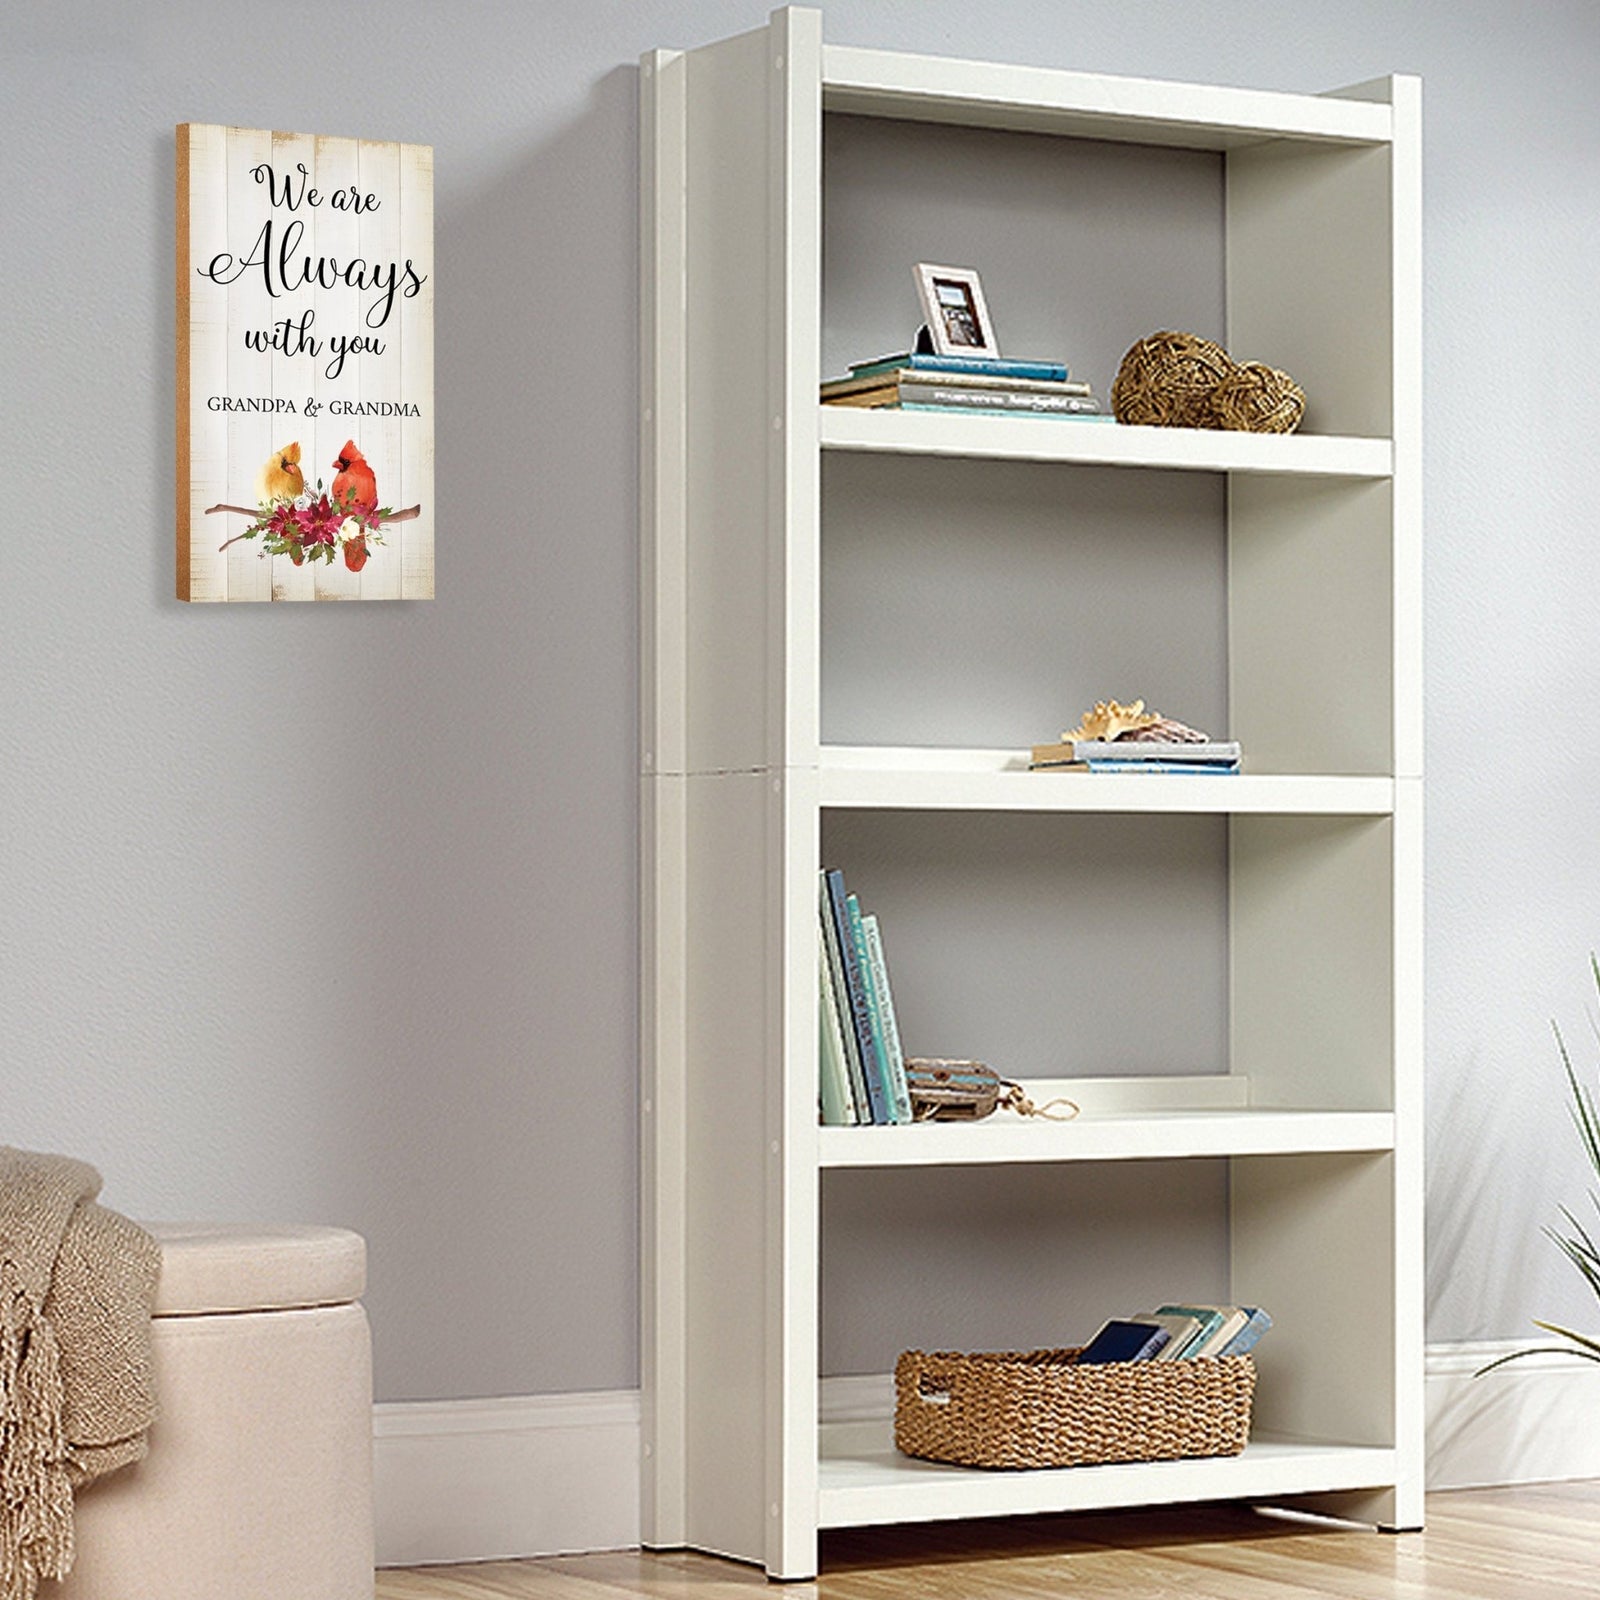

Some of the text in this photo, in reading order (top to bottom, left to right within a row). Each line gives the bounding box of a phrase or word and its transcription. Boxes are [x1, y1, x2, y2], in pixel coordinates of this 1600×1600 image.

[249, 163, 381, 214] We are
[197, 220, 428, 328] Always
[245, 309, 386, 379] with you
[207, 396, 421, 417] GRANDPA & GRANDMA
